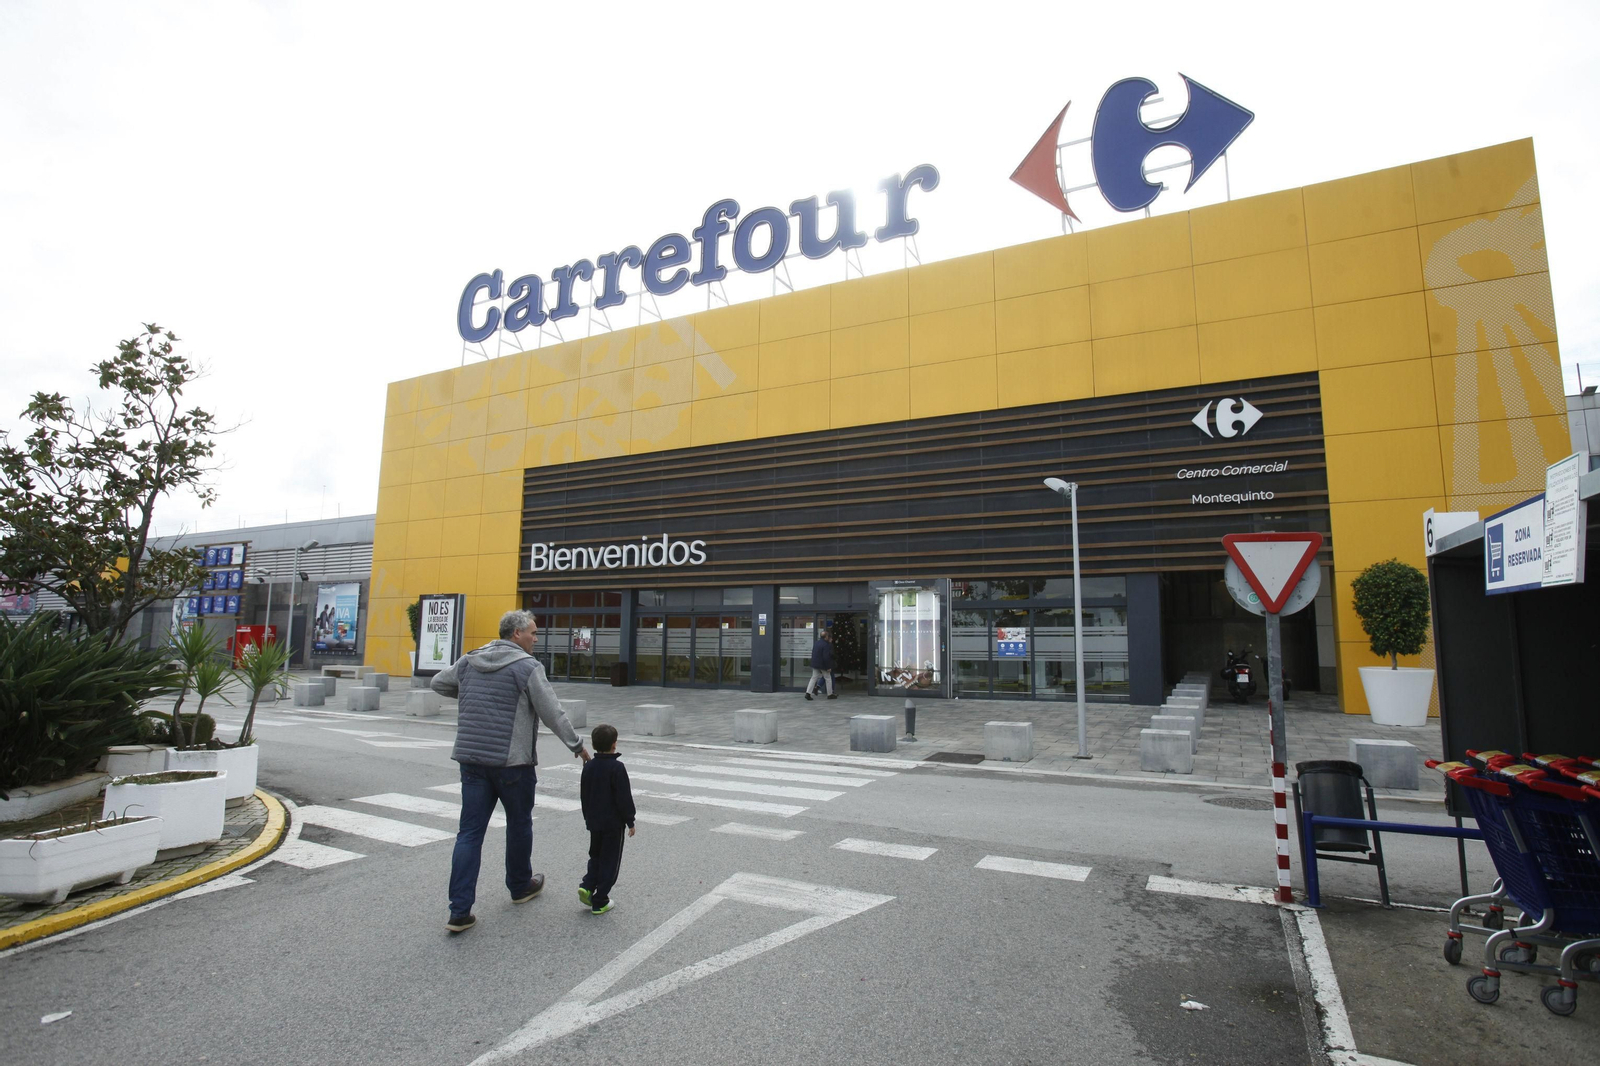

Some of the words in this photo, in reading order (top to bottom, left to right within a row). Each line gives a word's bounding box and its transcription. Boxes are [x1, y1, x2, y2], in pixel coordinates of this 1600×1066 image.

[456, 162, 940, 344] Carrefour
[1176, 467, 1219, 480] Centro
[1221, 461, 1288, 477] Comercial
[1191, 489, 1275, 506] Montequinto
[1426, 518, 1433, 548] 6
[1514, 526, 1531, 543] ZONA
[530, 533, 707, 572] Bienvenidos
[1508, 547, 1542, 567] RESERVADA
[336, 607, 350, 619] IVA
[428, 602, 438, 615] NO
[440, 601, 449, 615] ES
[427, 624, 448, 633] MUCHOS.
